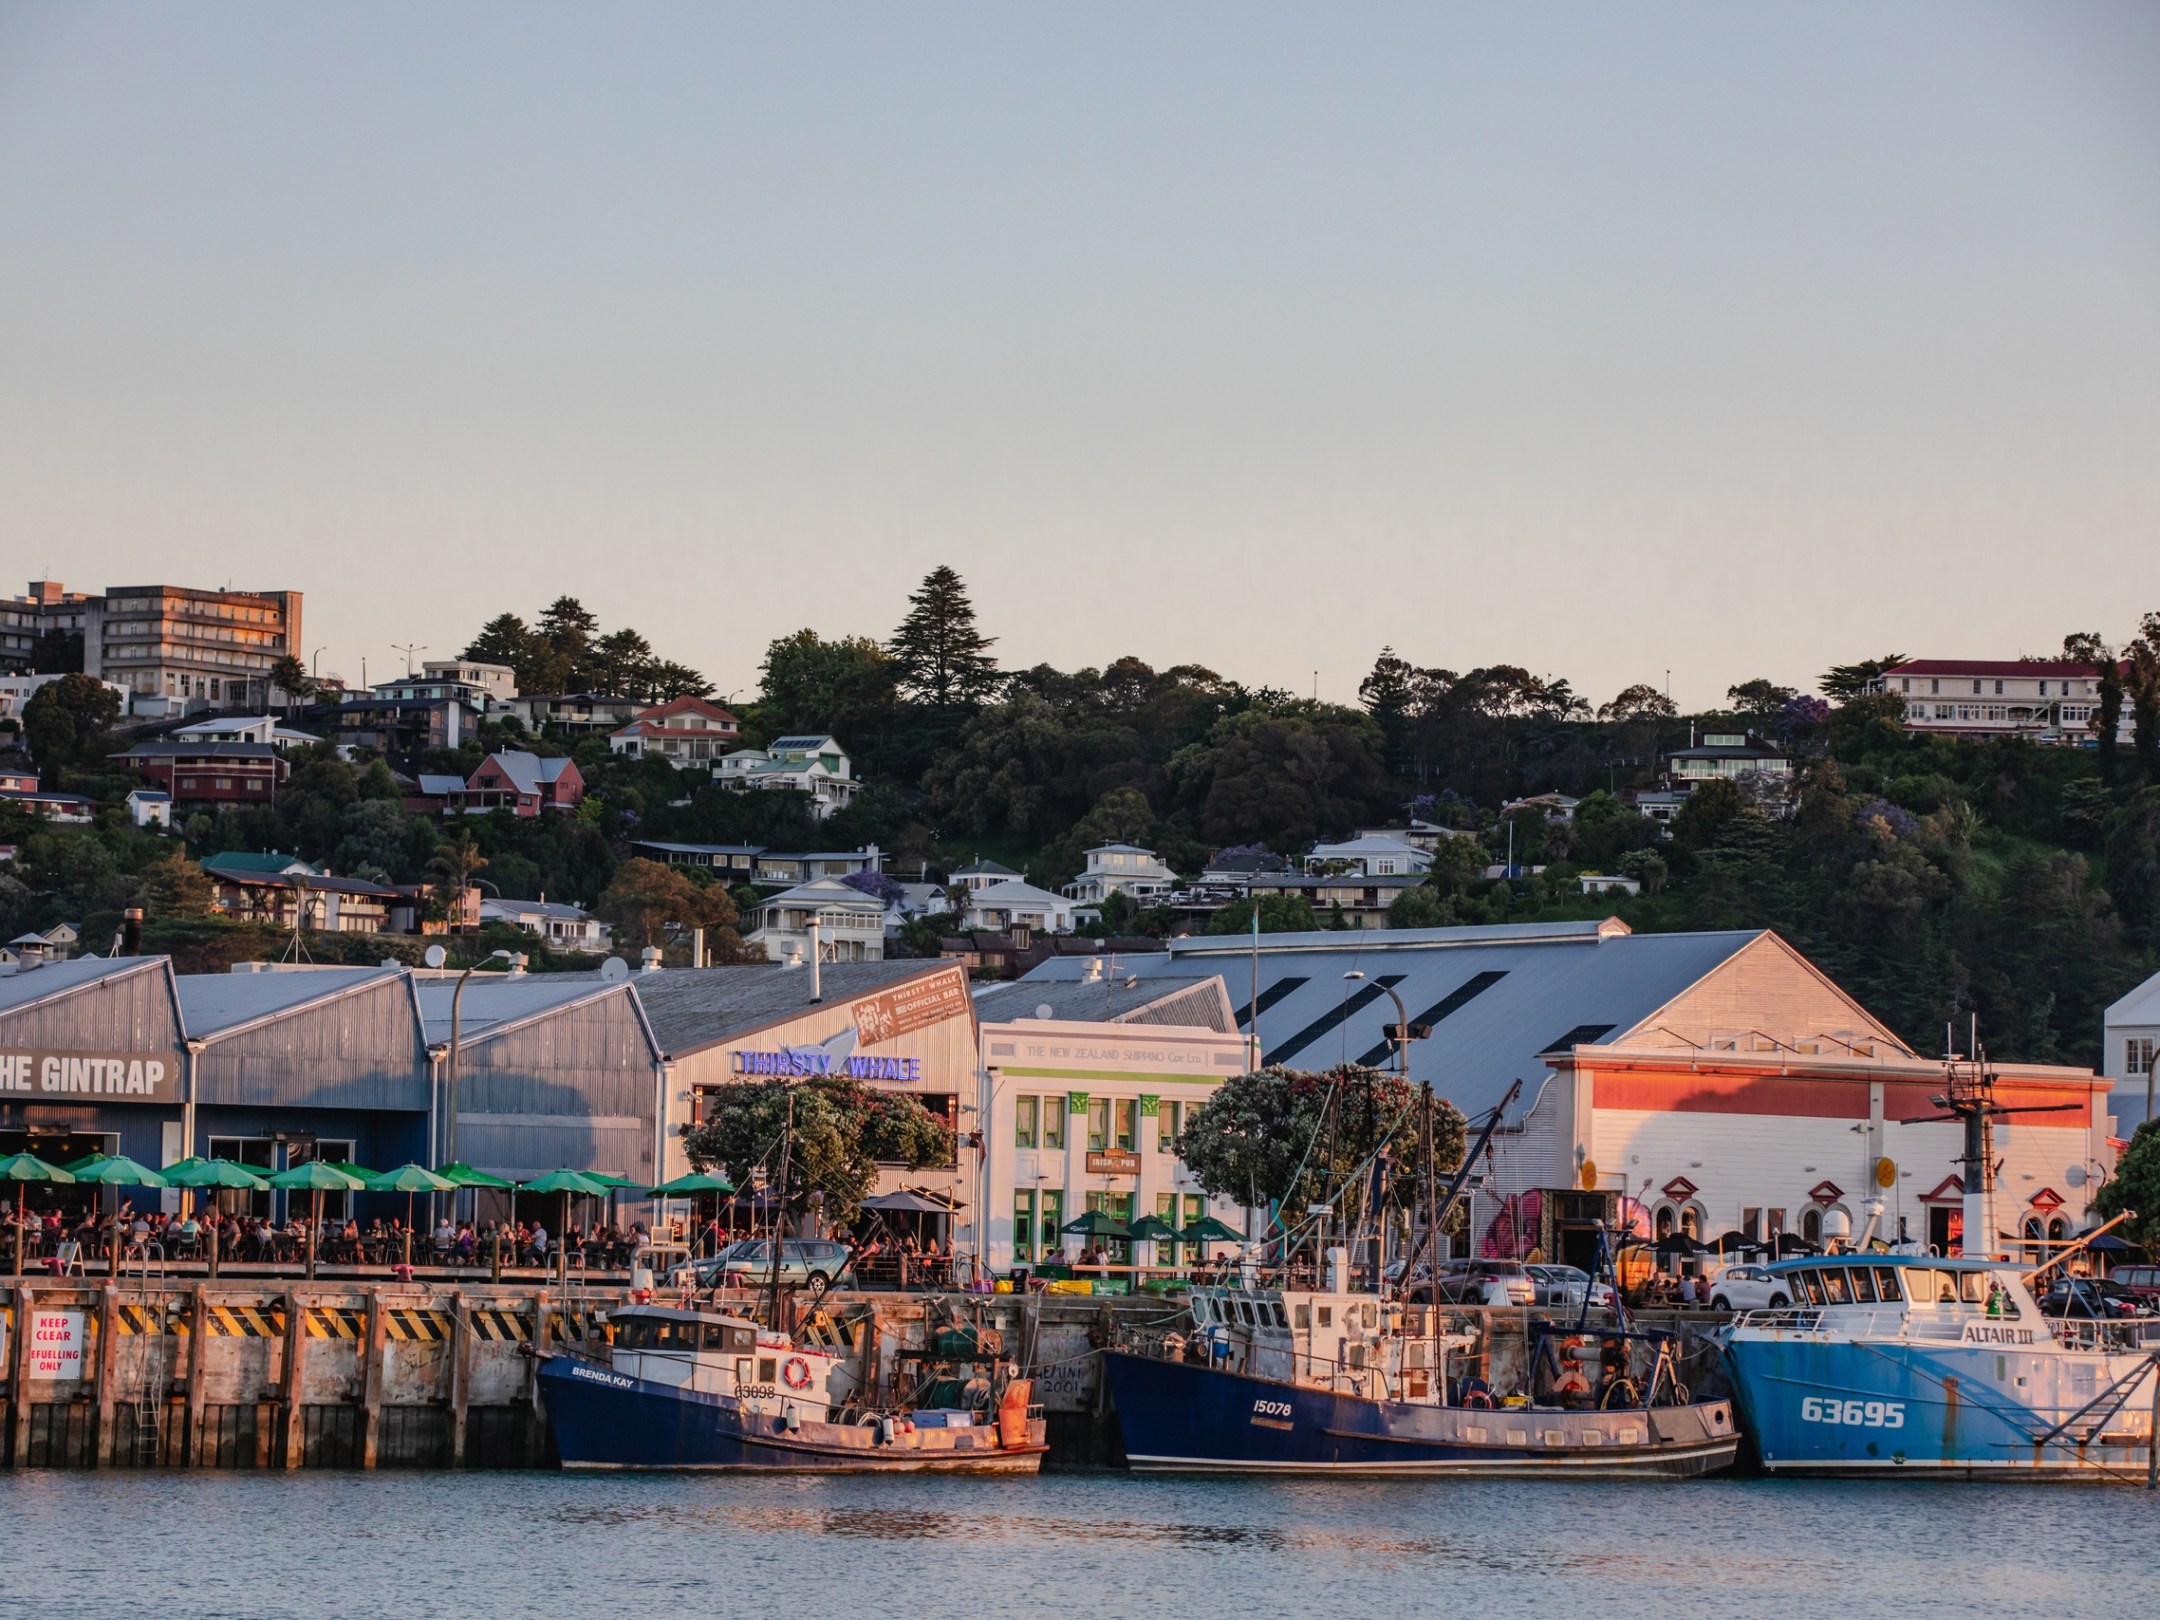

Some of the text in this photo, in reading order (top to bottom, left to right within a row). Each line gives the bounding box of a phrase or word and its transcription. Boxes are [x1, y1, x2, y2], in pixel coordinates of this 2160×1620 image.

[893, 975, 957, 1001] THIRSTY WHALE
[906, 994, 941, 1011] OFFICIAL
[942, 988, 959, 999] BAR
[1027, 1046, 1046, 1057] THE
[1049, 1047, 1070, 1058] NEW
[1074, 1048, 1120, 1061] ZEALAND
[1123, 1050, 1164, 1063] SHIPPING
[741, 1051, 921, 1081] THIRSTY WHALE
[0, 1055, 164, 1095] HE GINTRAP
[1092, 1158, 1135, 1167] IRISH PUB
[40, 1318, 69, 1328] KEEP
[36, 1331, 71, 1341] CLEAR
[1966, 1327, 2034, 1345] ALTAIR III
[31, 1350, 79, 1359] EFUELLING
[39, 1362, 62, 1371] ONLY
[572, 1366, 634, 1388] BRENDA KAY
[735, 1385, 775, 1399] 63098
[1044, 1381, 1078, 1393] 2001
[1253, 1400, 1292, 1416] 15078
[1802, 1397, 1905, 1428] 63695
